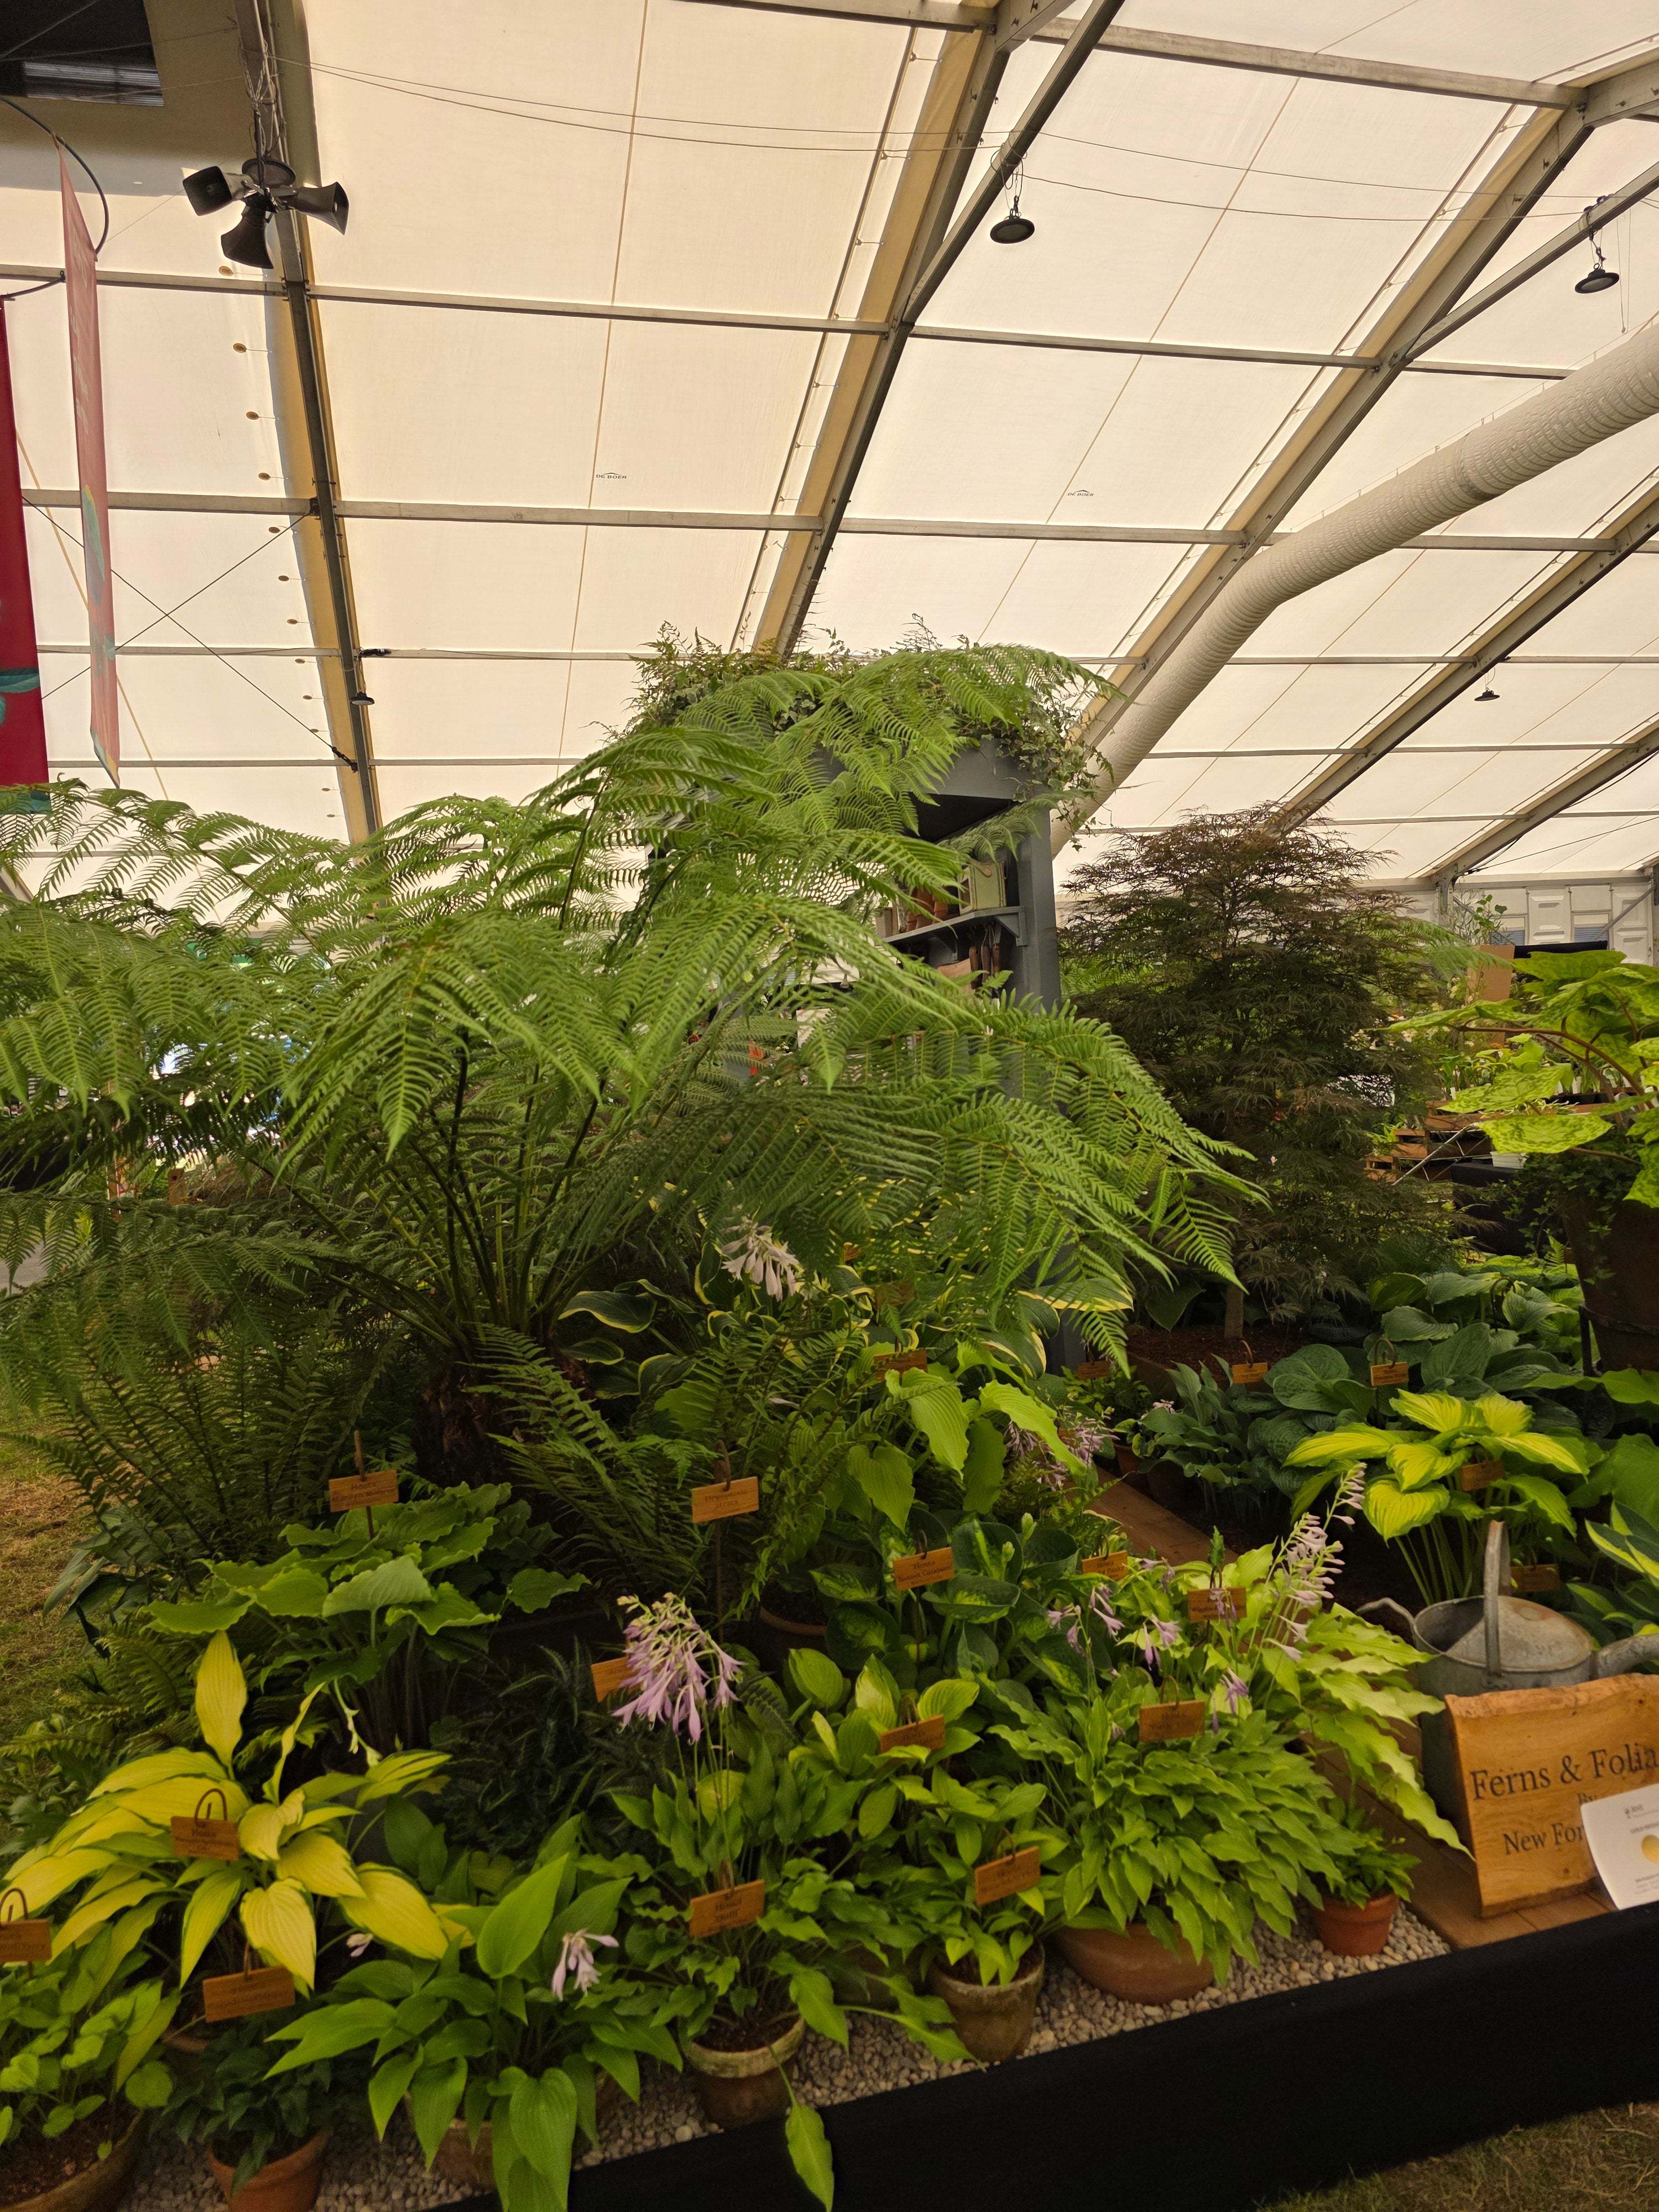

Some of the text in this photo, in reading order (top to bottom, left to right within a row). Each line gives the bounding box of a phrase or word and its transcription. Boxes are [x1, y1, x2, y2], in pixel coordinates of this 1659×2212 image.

[1469, 1767, 1551, 1801] Ferns
[1559, 1754, 1582, 1785] &
[1502, 1830, 1548, 1856] New
